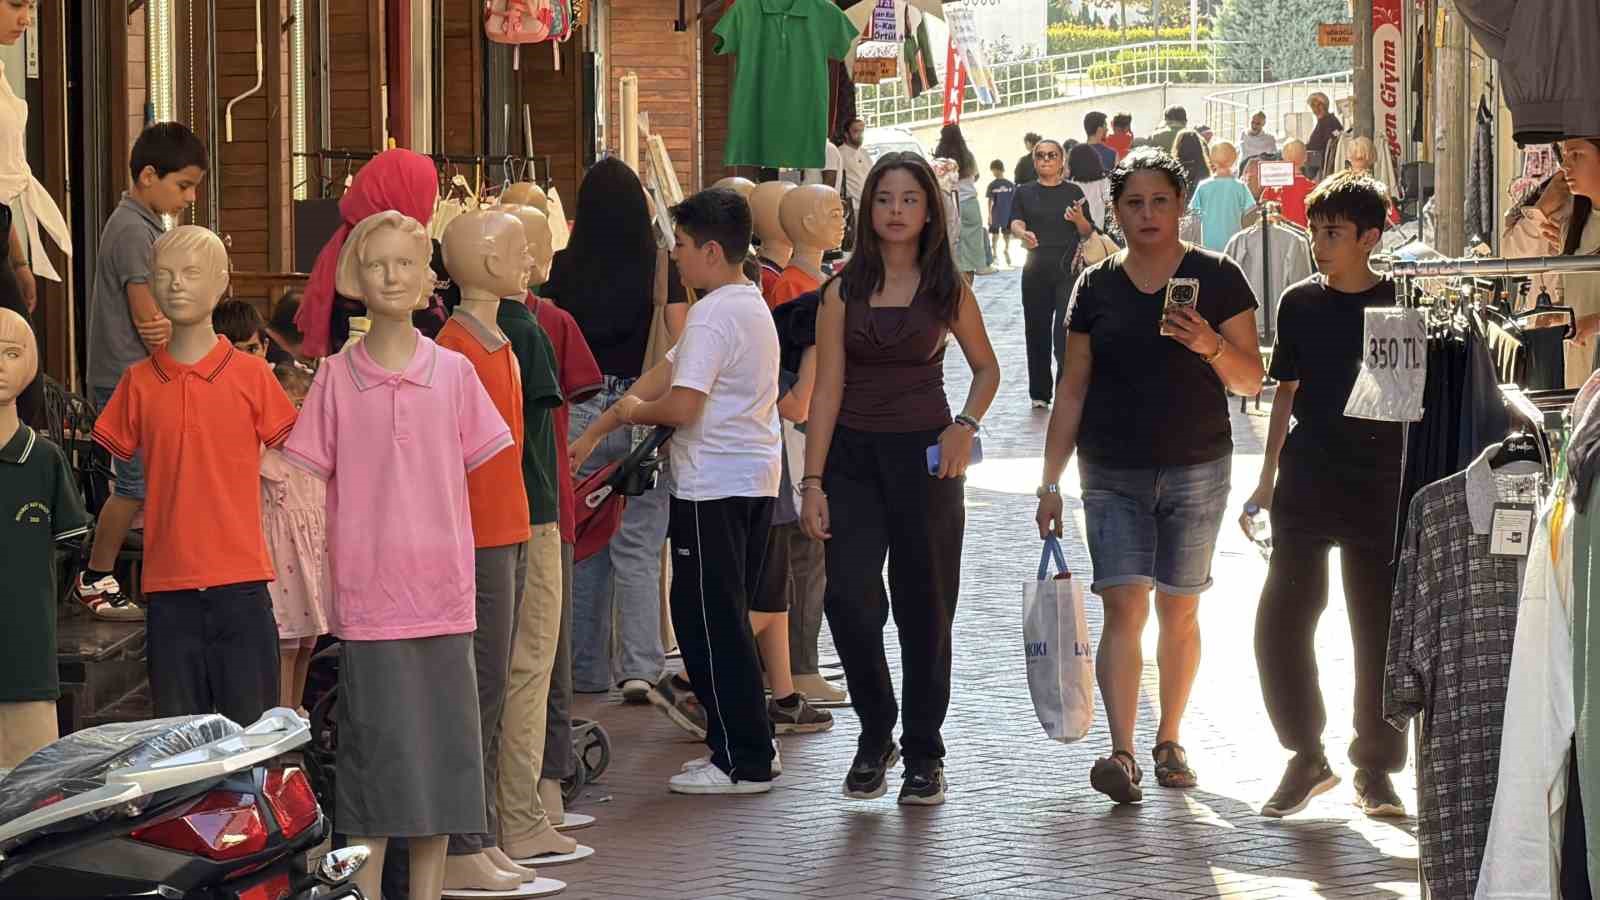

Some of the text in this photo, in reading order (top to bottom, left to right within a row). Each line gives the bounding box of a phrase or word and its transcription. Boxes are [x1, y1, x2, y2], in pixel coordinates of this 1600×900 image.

[1380, 40, 1400, 108] Giyim
[1366, 337, 1421, 369] 350 TL
